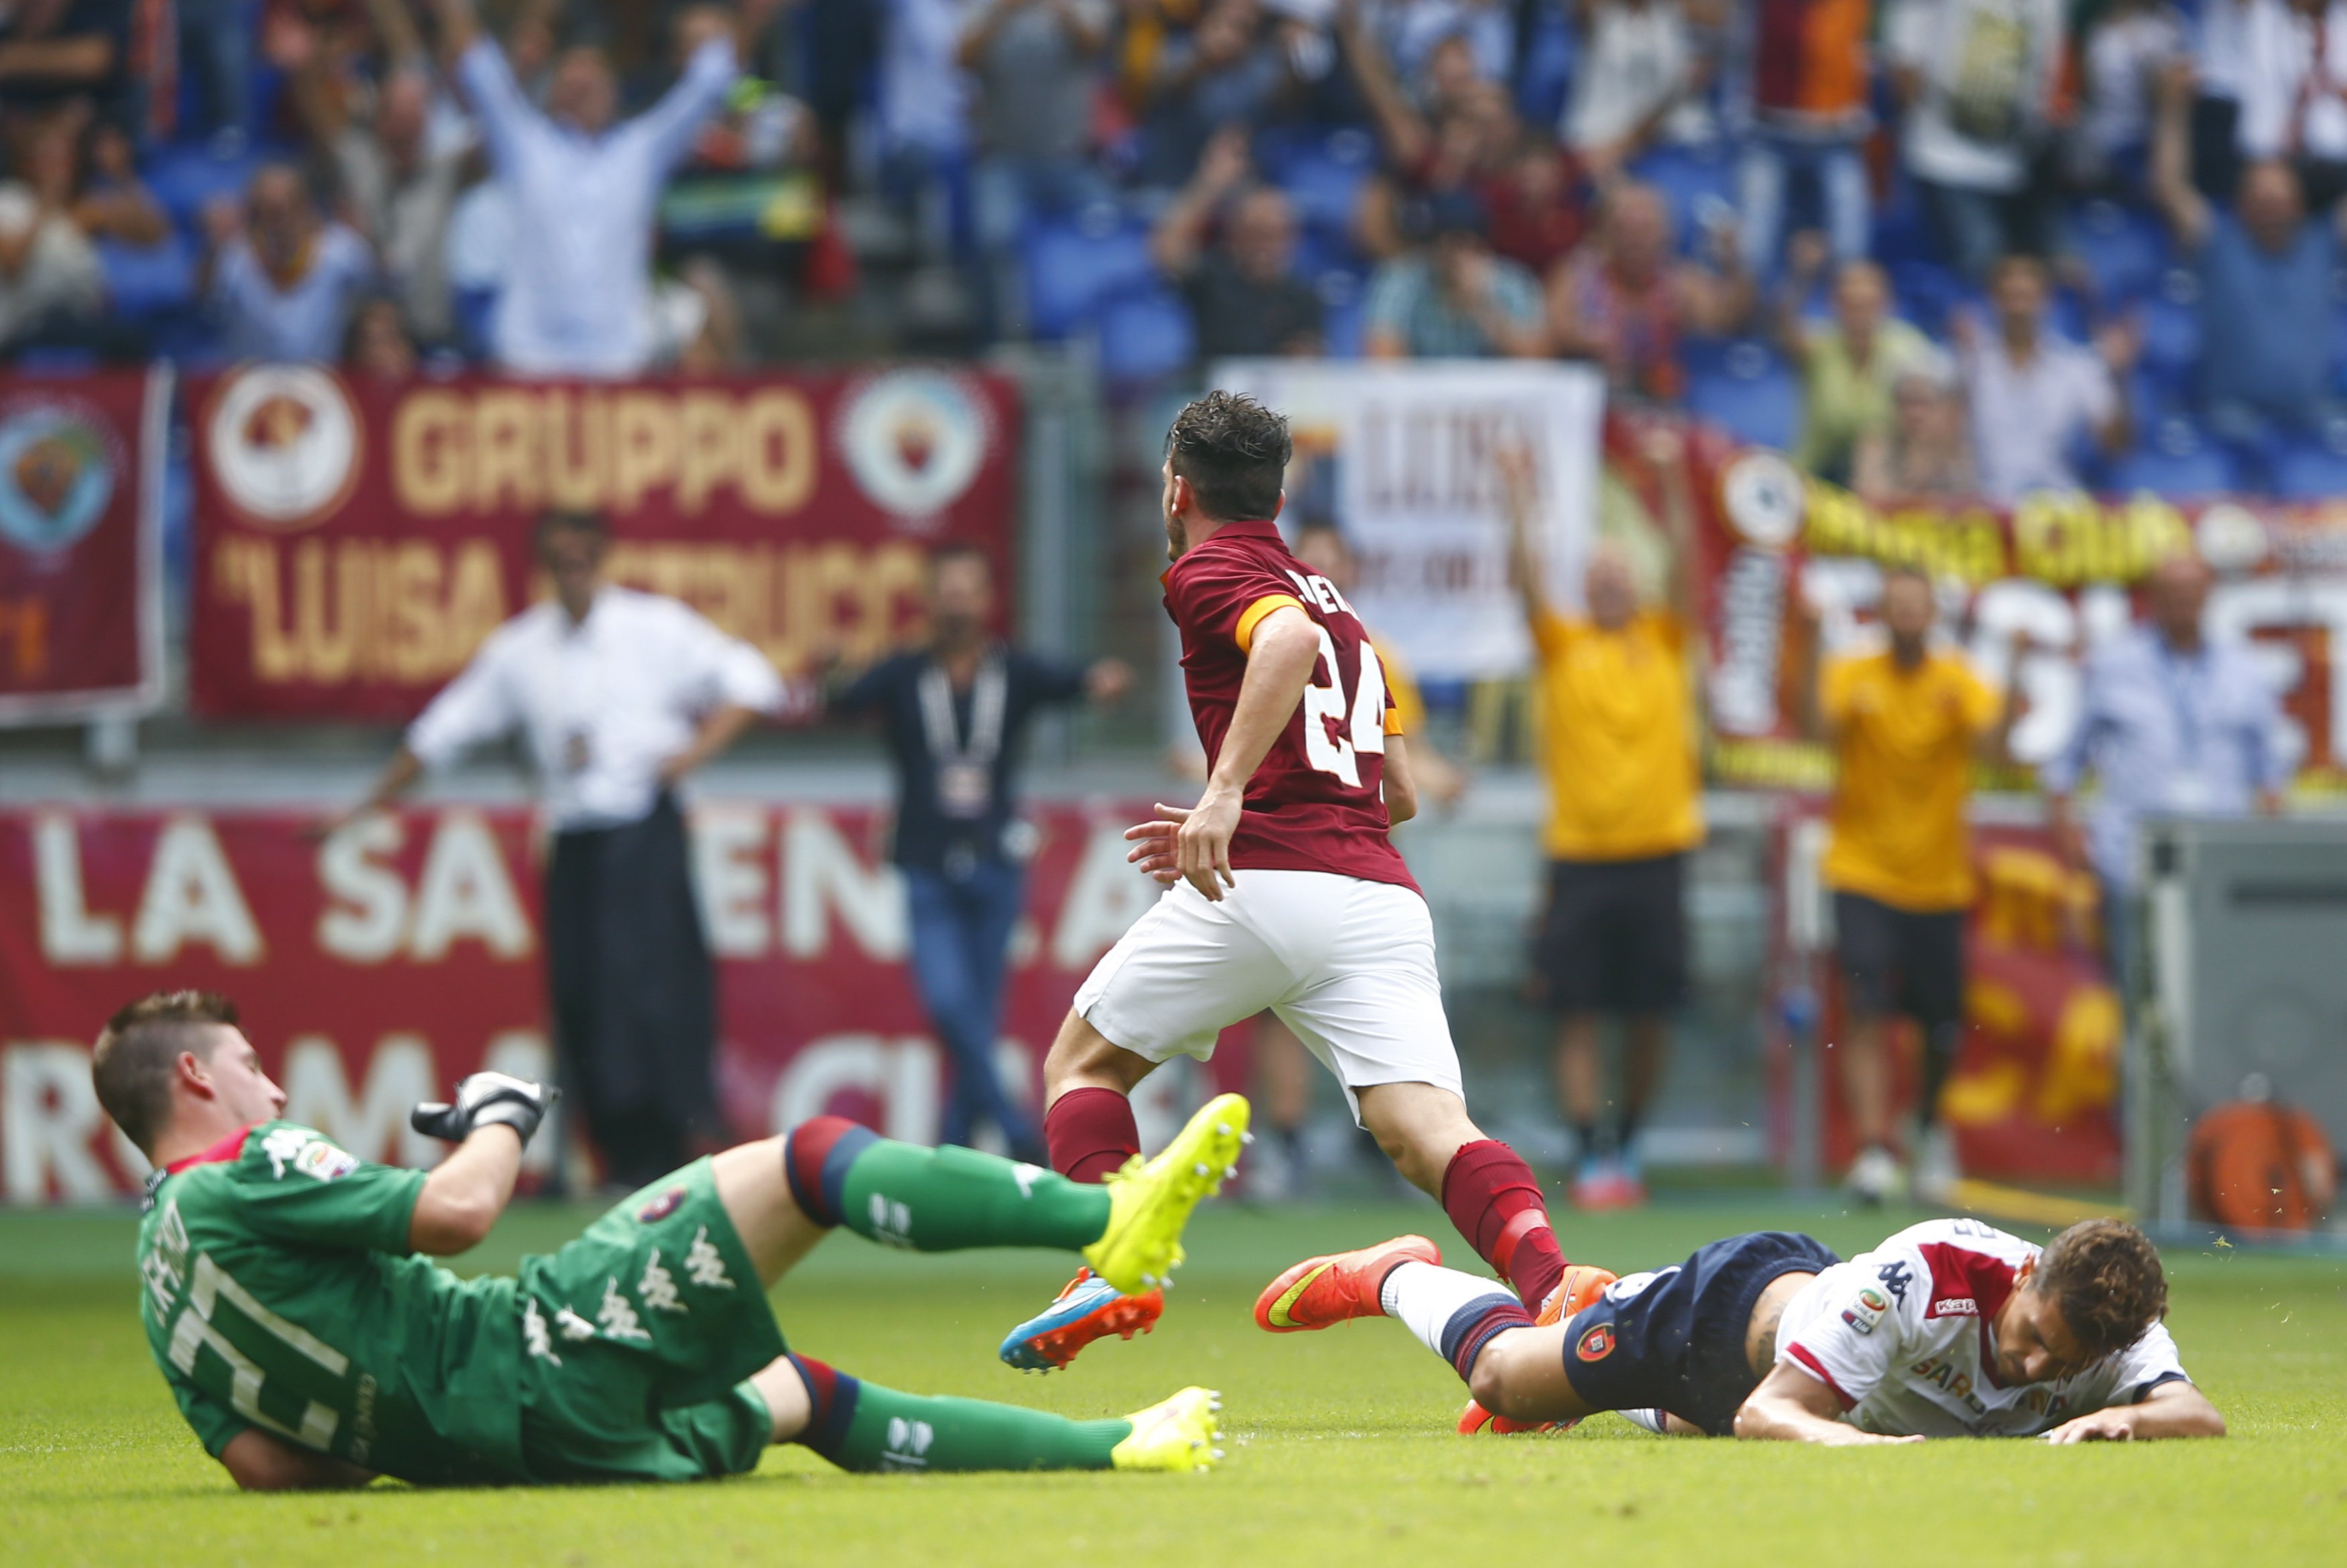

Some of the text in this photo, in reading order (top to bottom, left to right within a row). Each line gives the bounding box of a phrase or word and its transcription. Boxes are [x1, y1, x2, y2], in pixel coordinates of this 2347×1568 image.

[393, 387, 817, 515] GRUPPO
[1304, 621, 1385, 789] 24
[35, 815, 264, 967] LA
[168, 1250, 350, 1456] 27
[1851, 1318, 1871, 1334] TIM
[1935, 1298, 1979, 1316] Kap
